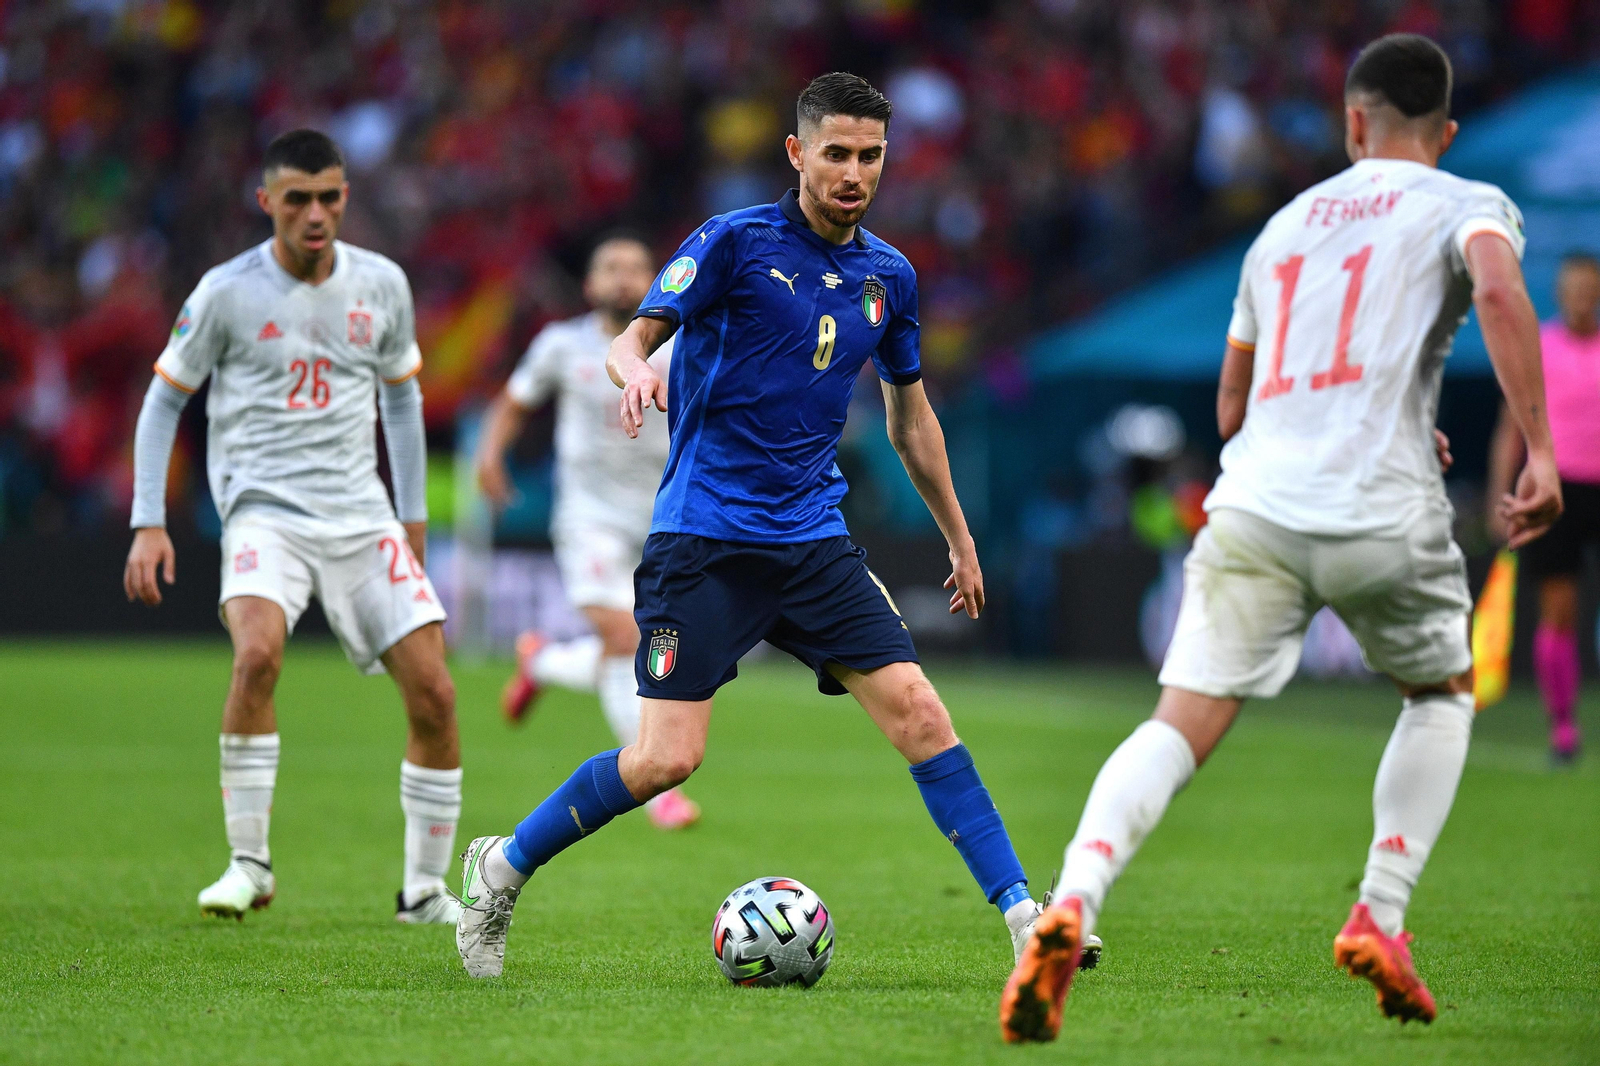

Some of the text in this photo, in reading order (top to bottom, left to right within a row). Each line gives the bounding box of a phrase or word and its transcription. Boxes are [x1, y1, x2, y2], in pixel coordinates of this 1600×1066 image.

[865, 284, 884, 296] ITALIA
[812, 314, 837, 371] 8
[1254, 243, 1374, 402] 11
[287, 356, 332, 409] 26
[652, 639, 676, 647] ITALIA
